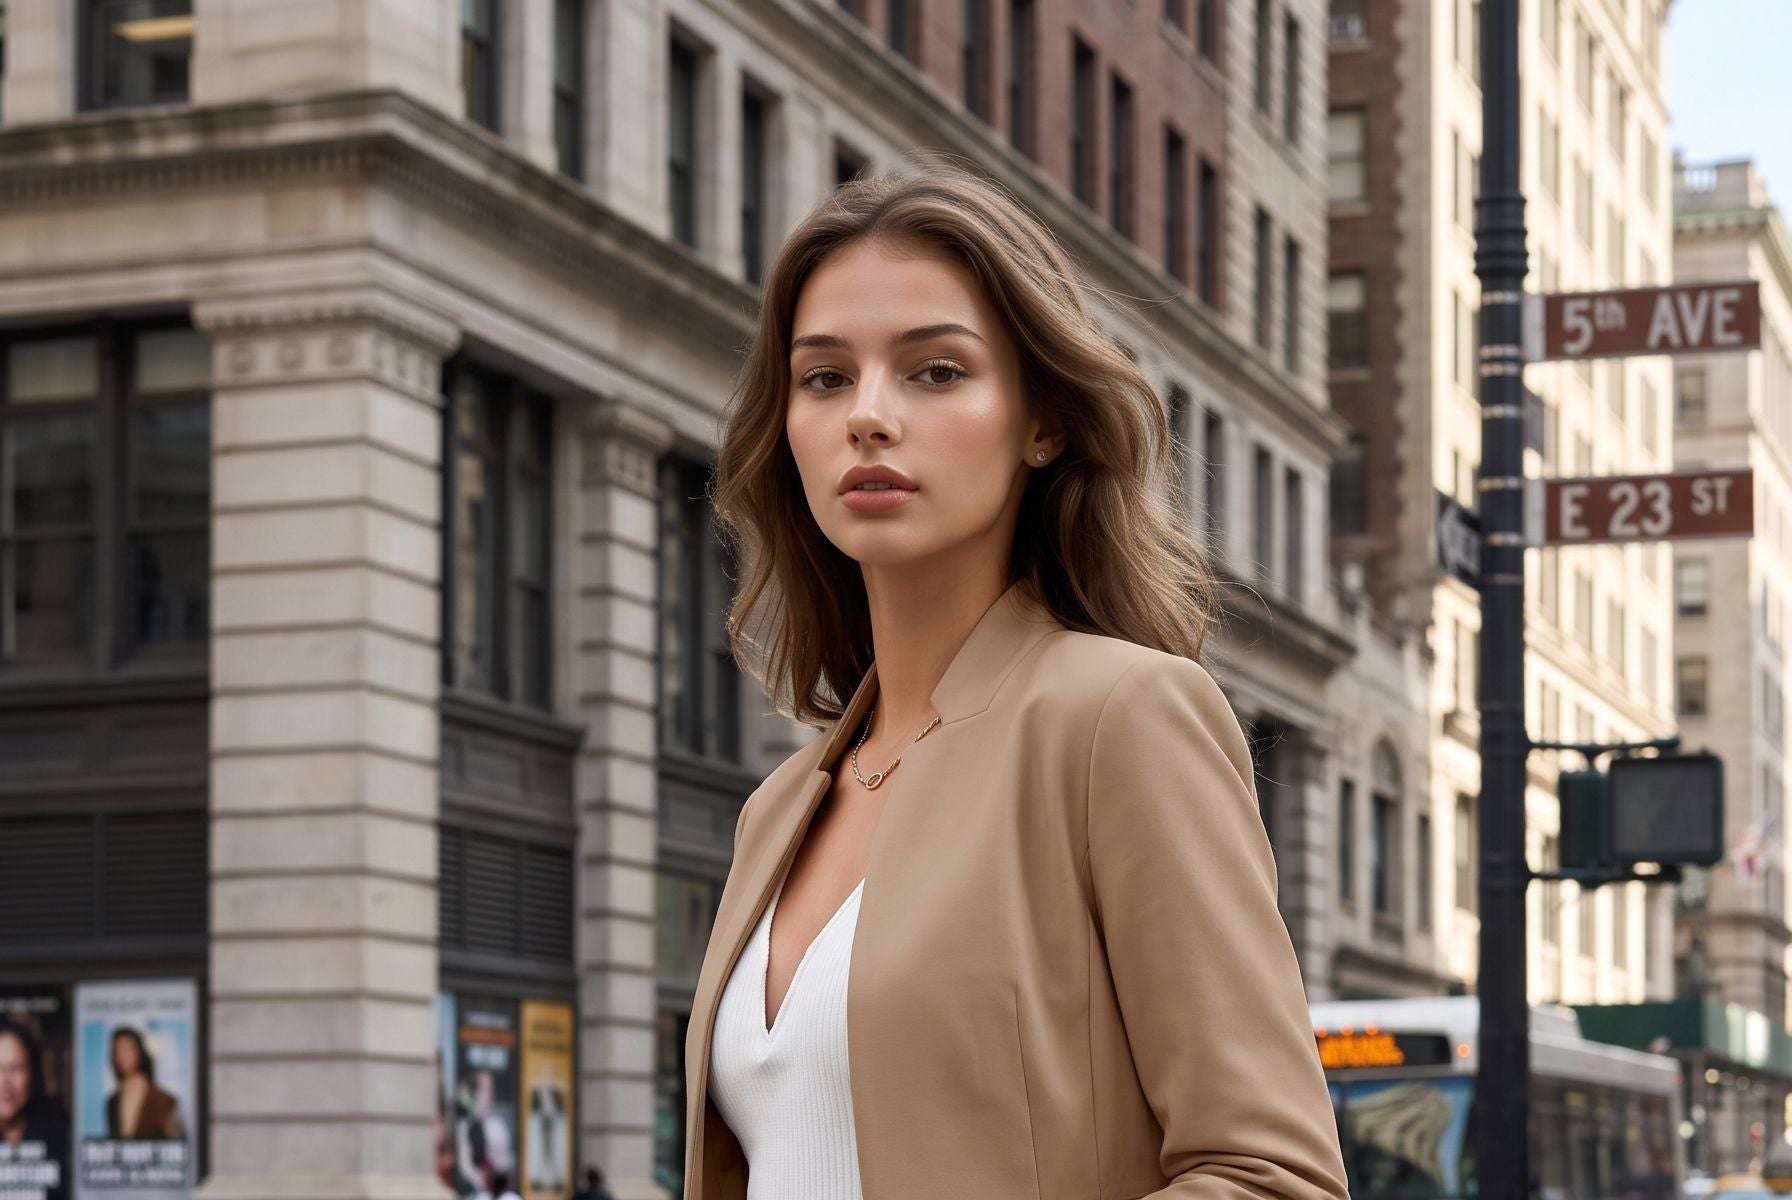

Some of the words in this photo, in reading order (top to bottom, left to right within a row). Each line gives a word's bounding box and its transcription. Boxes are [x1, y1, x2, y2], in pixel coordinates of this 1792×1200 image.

[1562, 297, 1626, 354] 5th
[1647, 290, 1742, 348] AVE
[1560, 485, 1589, 538] E
[1608, 481, 1672, 537] 23
[1691, 478, 1732, 515] ST
